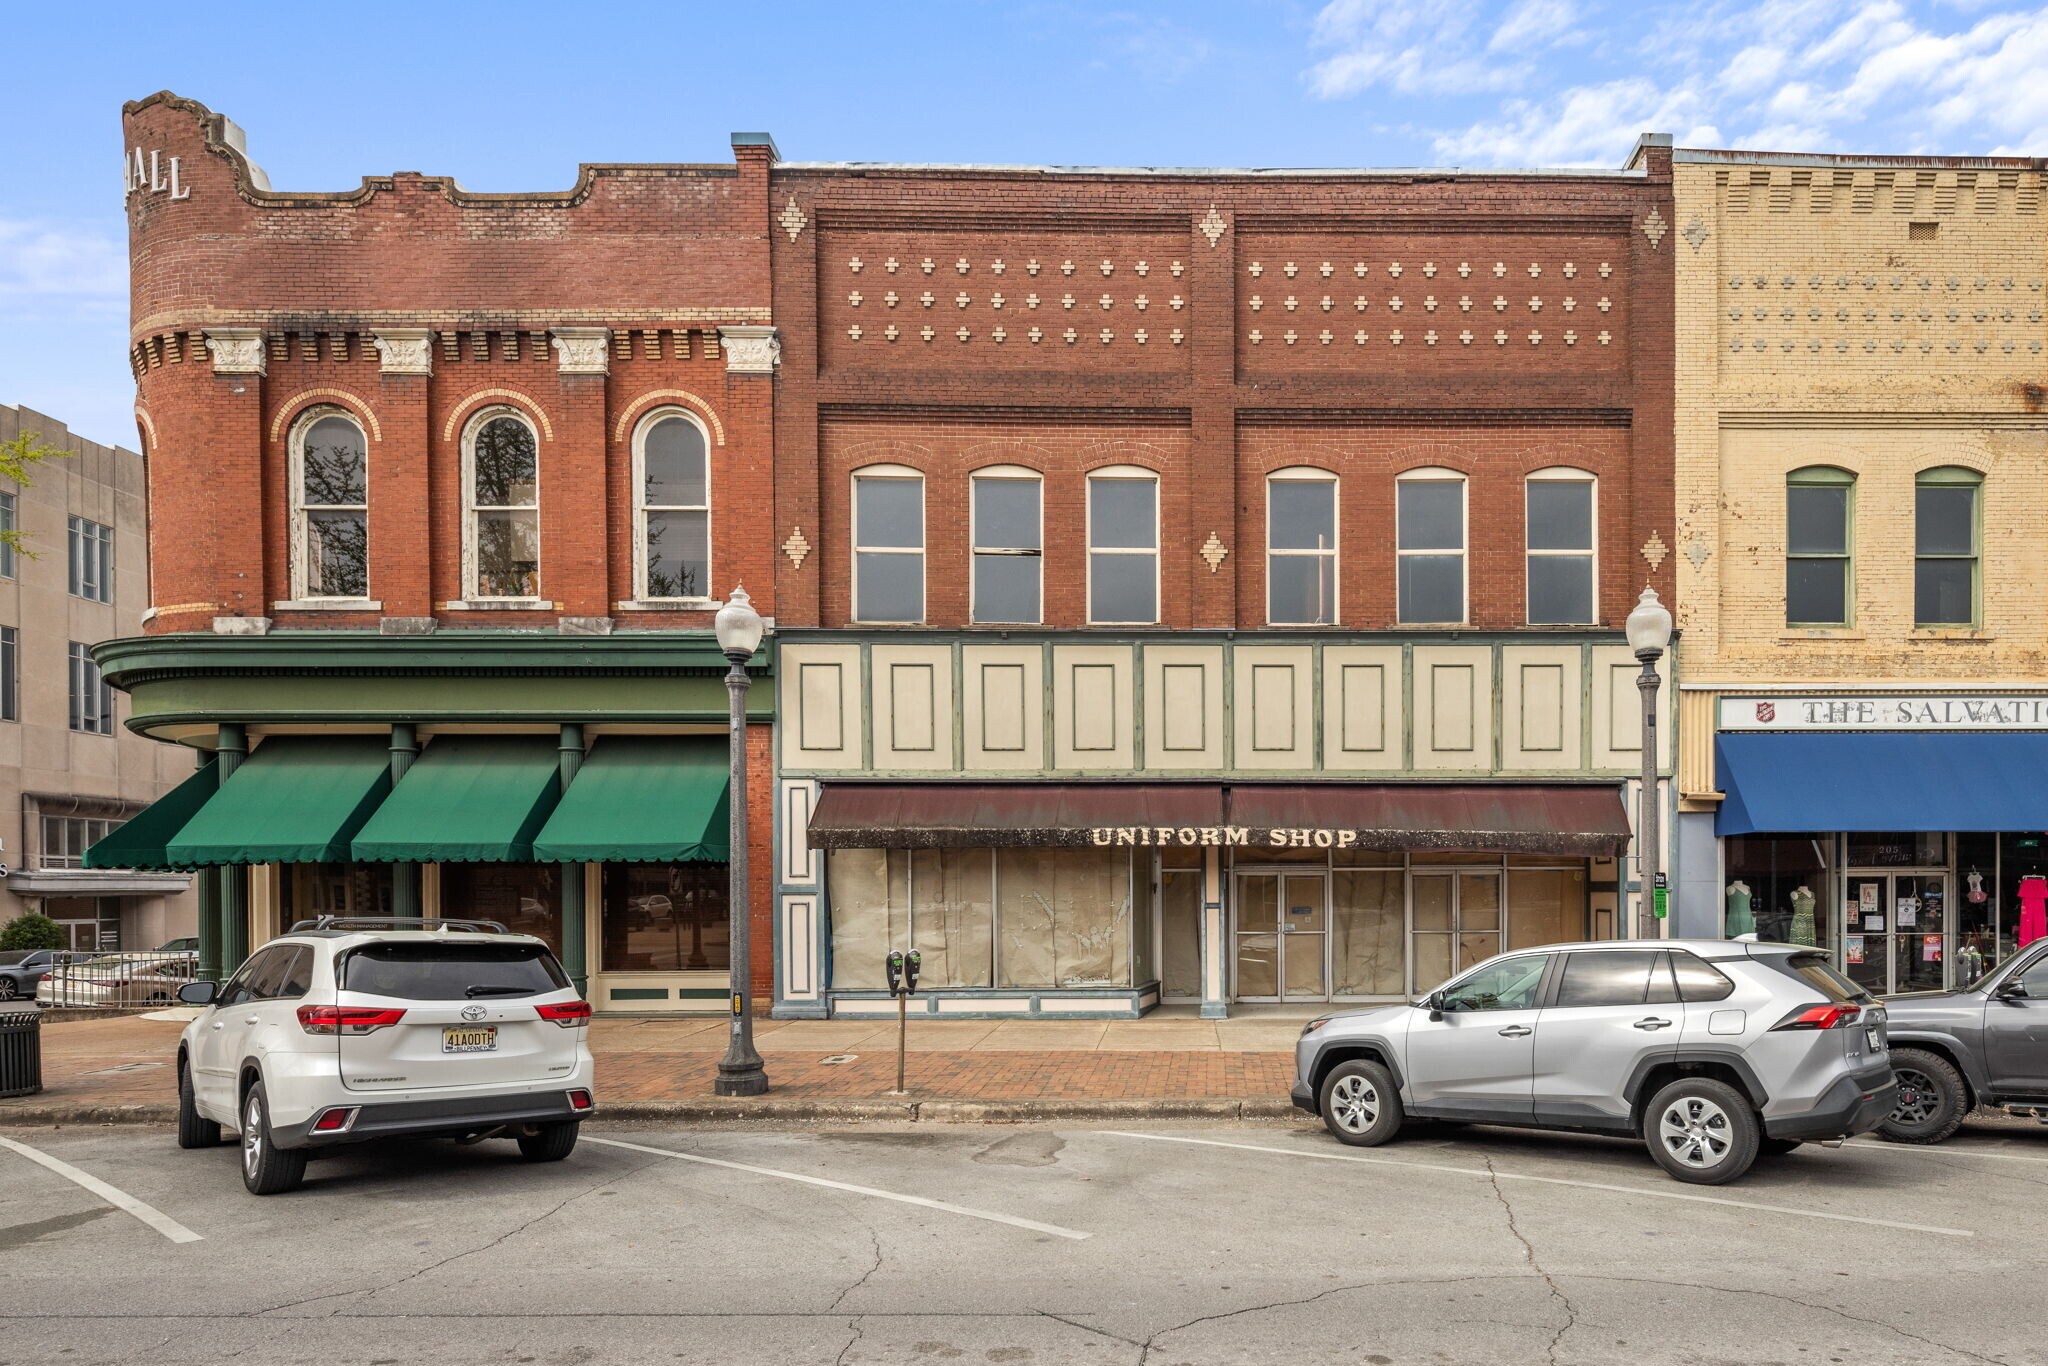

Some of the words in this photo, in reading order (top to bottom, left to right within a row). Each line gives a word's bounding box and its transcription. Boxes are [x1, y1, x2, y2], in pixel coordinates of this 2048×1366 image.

[1802, 701, 1876, 724] THE
[1896, 700, 2048, 724] SALVATI
[1091, 827, 1249, 846] UNIFORM
[1269, 828, 1357, 848] SHOP
